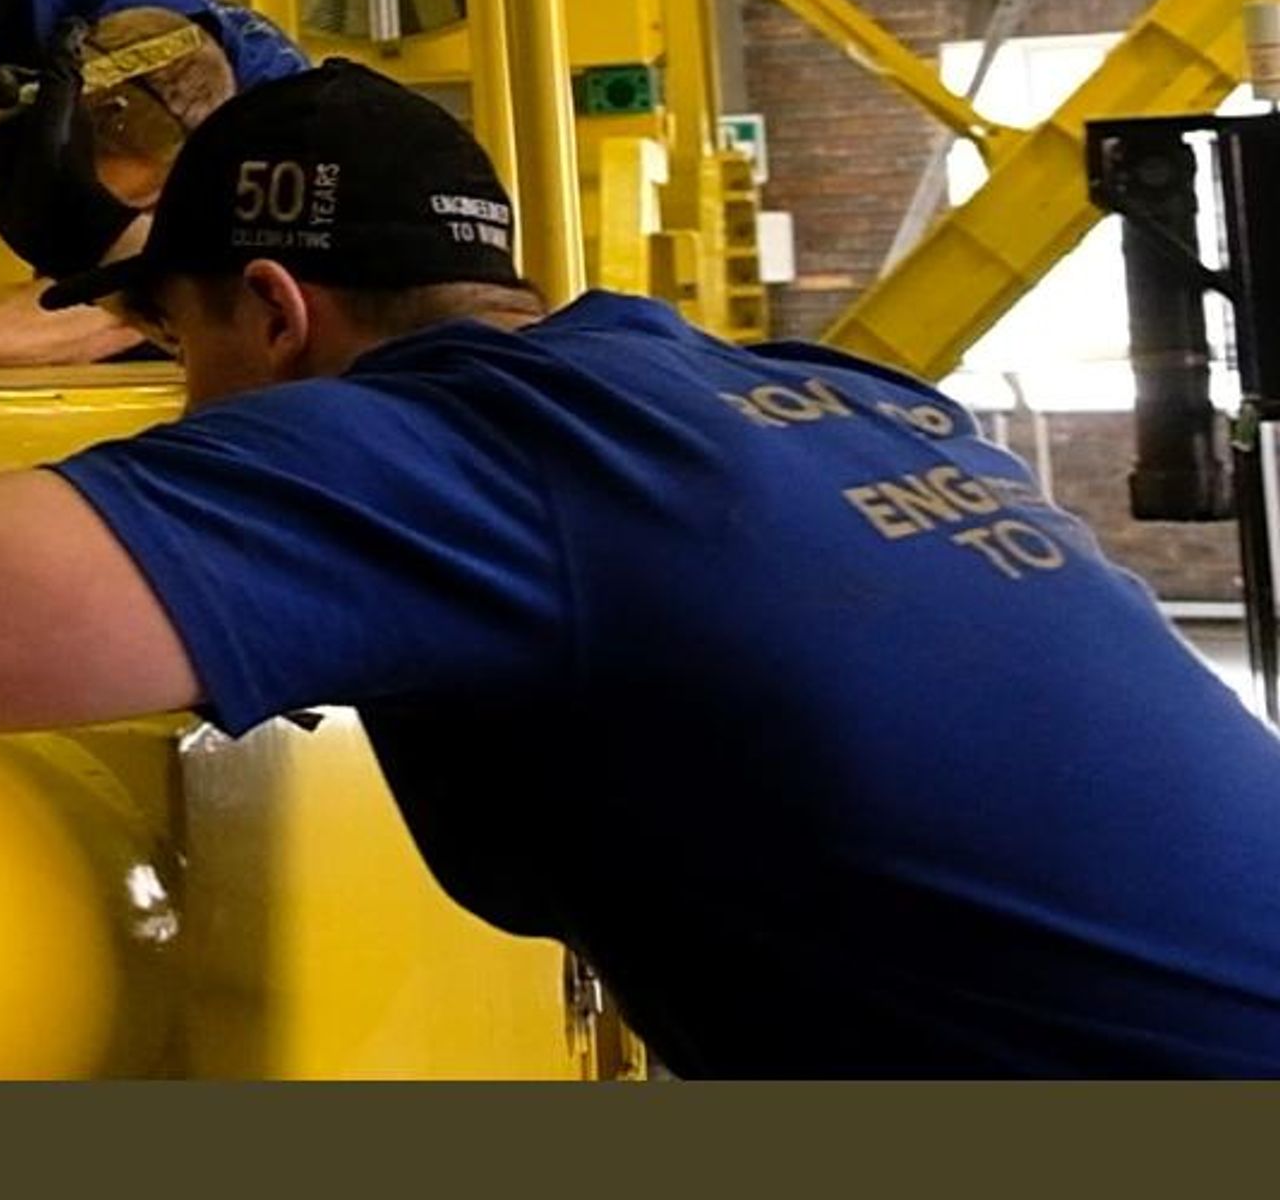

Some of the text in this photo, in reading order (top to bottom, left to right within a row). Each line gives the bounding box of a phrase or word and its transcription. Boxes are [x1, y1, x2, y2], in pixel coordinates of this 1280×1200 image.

[234, 160, 305, 221] 50
[308, 162, 341, 225] YEARS
[446, 221, 475, 242] TO
[949, 518, 1064, 579] TO
